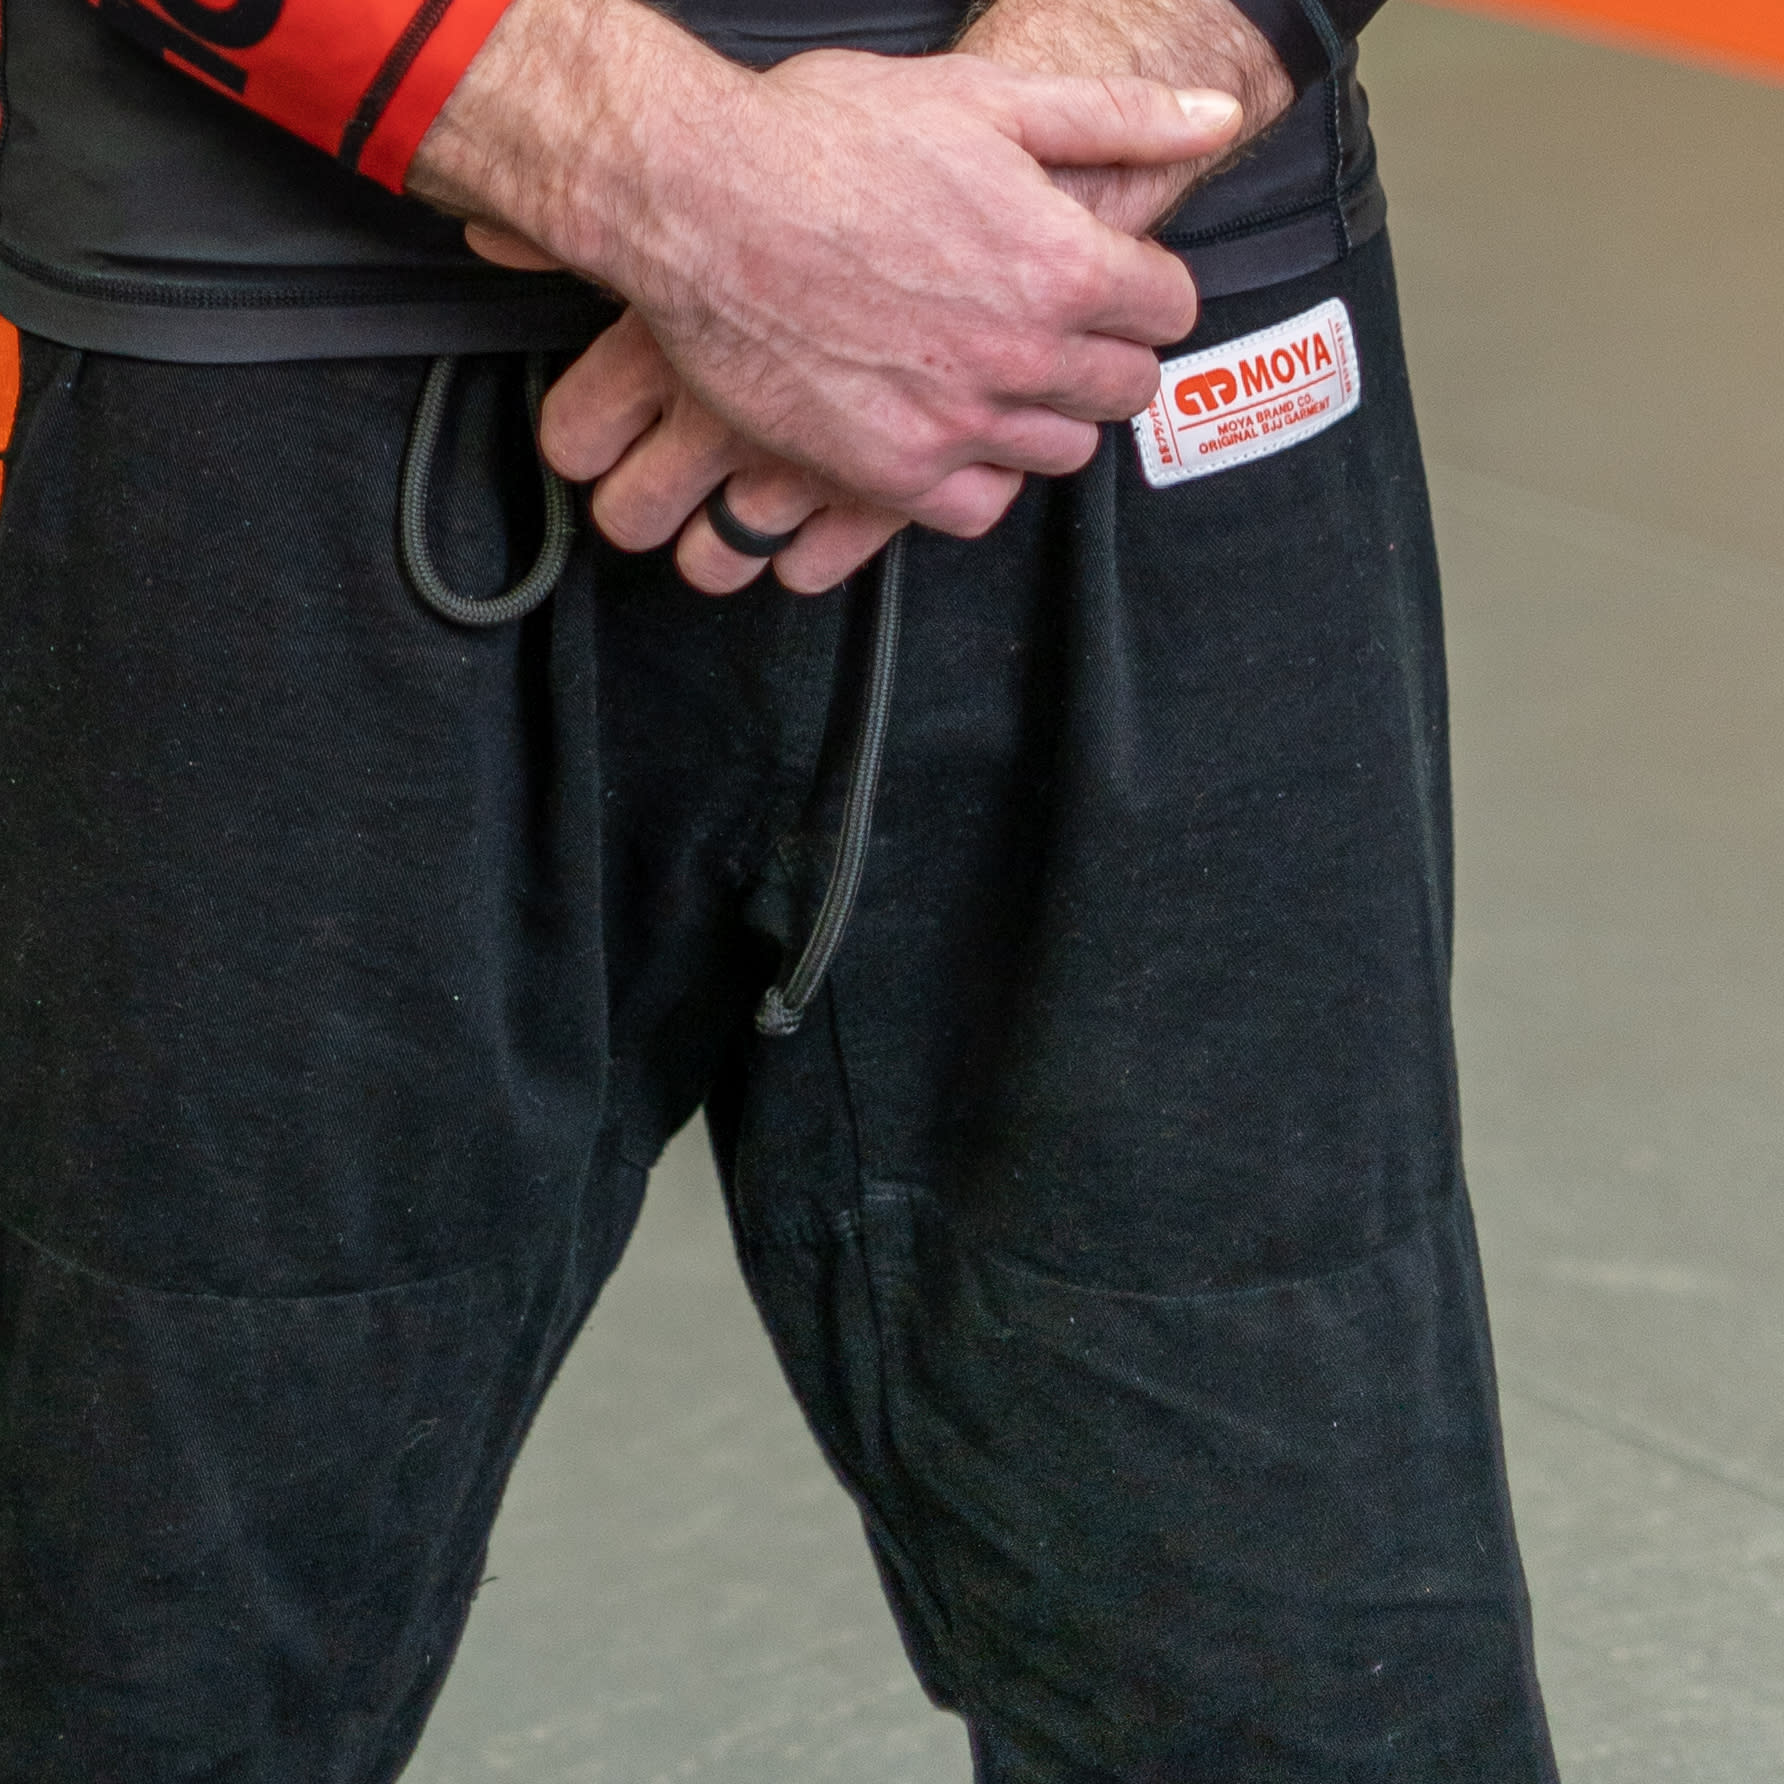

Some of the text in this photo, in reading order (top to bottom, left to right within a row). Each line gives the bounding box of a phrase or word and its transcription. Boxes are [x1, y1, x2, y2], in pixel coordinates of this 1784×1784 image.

[1238, 332, 1333, 397] MOYA
[1199, 428, 1259, 455] ORIGINAL
[1261, 418, 1284, 435] BJJ
[1284, 396, 1330, 425] GARMENT
[1217, 415, 1255, 436] MOYA
[1256, 400, 1295, 424] BRAND
